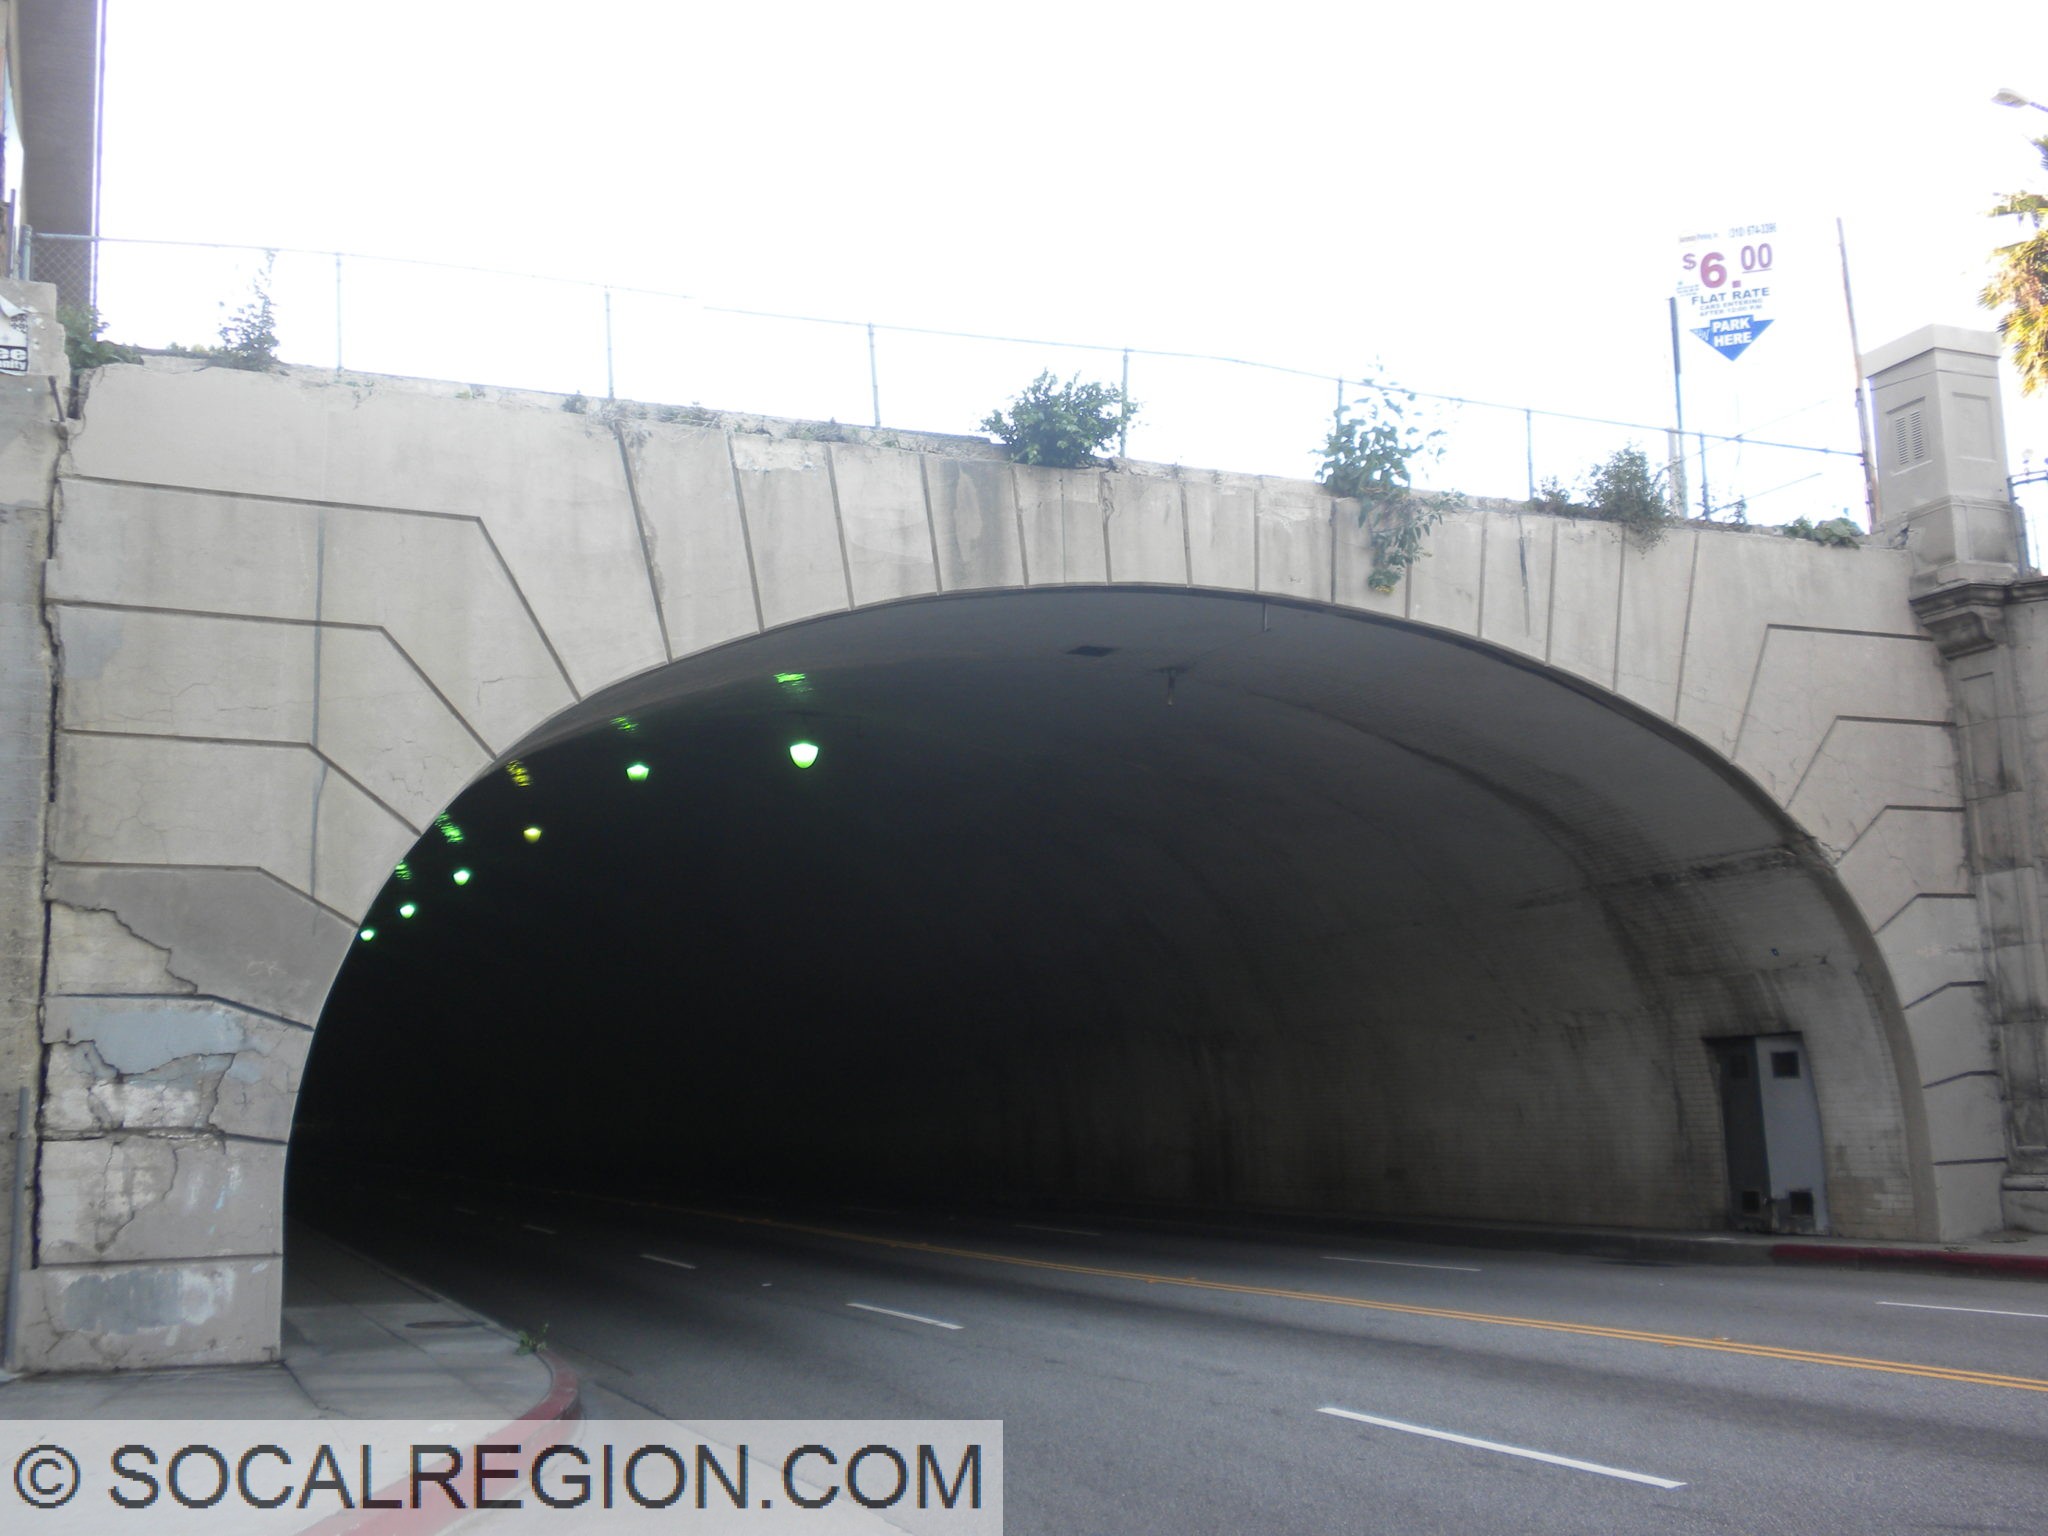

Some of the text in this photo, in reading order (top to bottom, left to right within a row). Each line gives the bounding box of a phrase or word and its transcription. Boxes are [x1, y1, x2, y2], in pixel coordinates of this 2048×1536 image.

[1691, 287, 1770, 305] FLAT RATE
[1700, 298, 1763, 311] CARS ENTERING
[1712, 317, 1753, 347] PARK HERE
